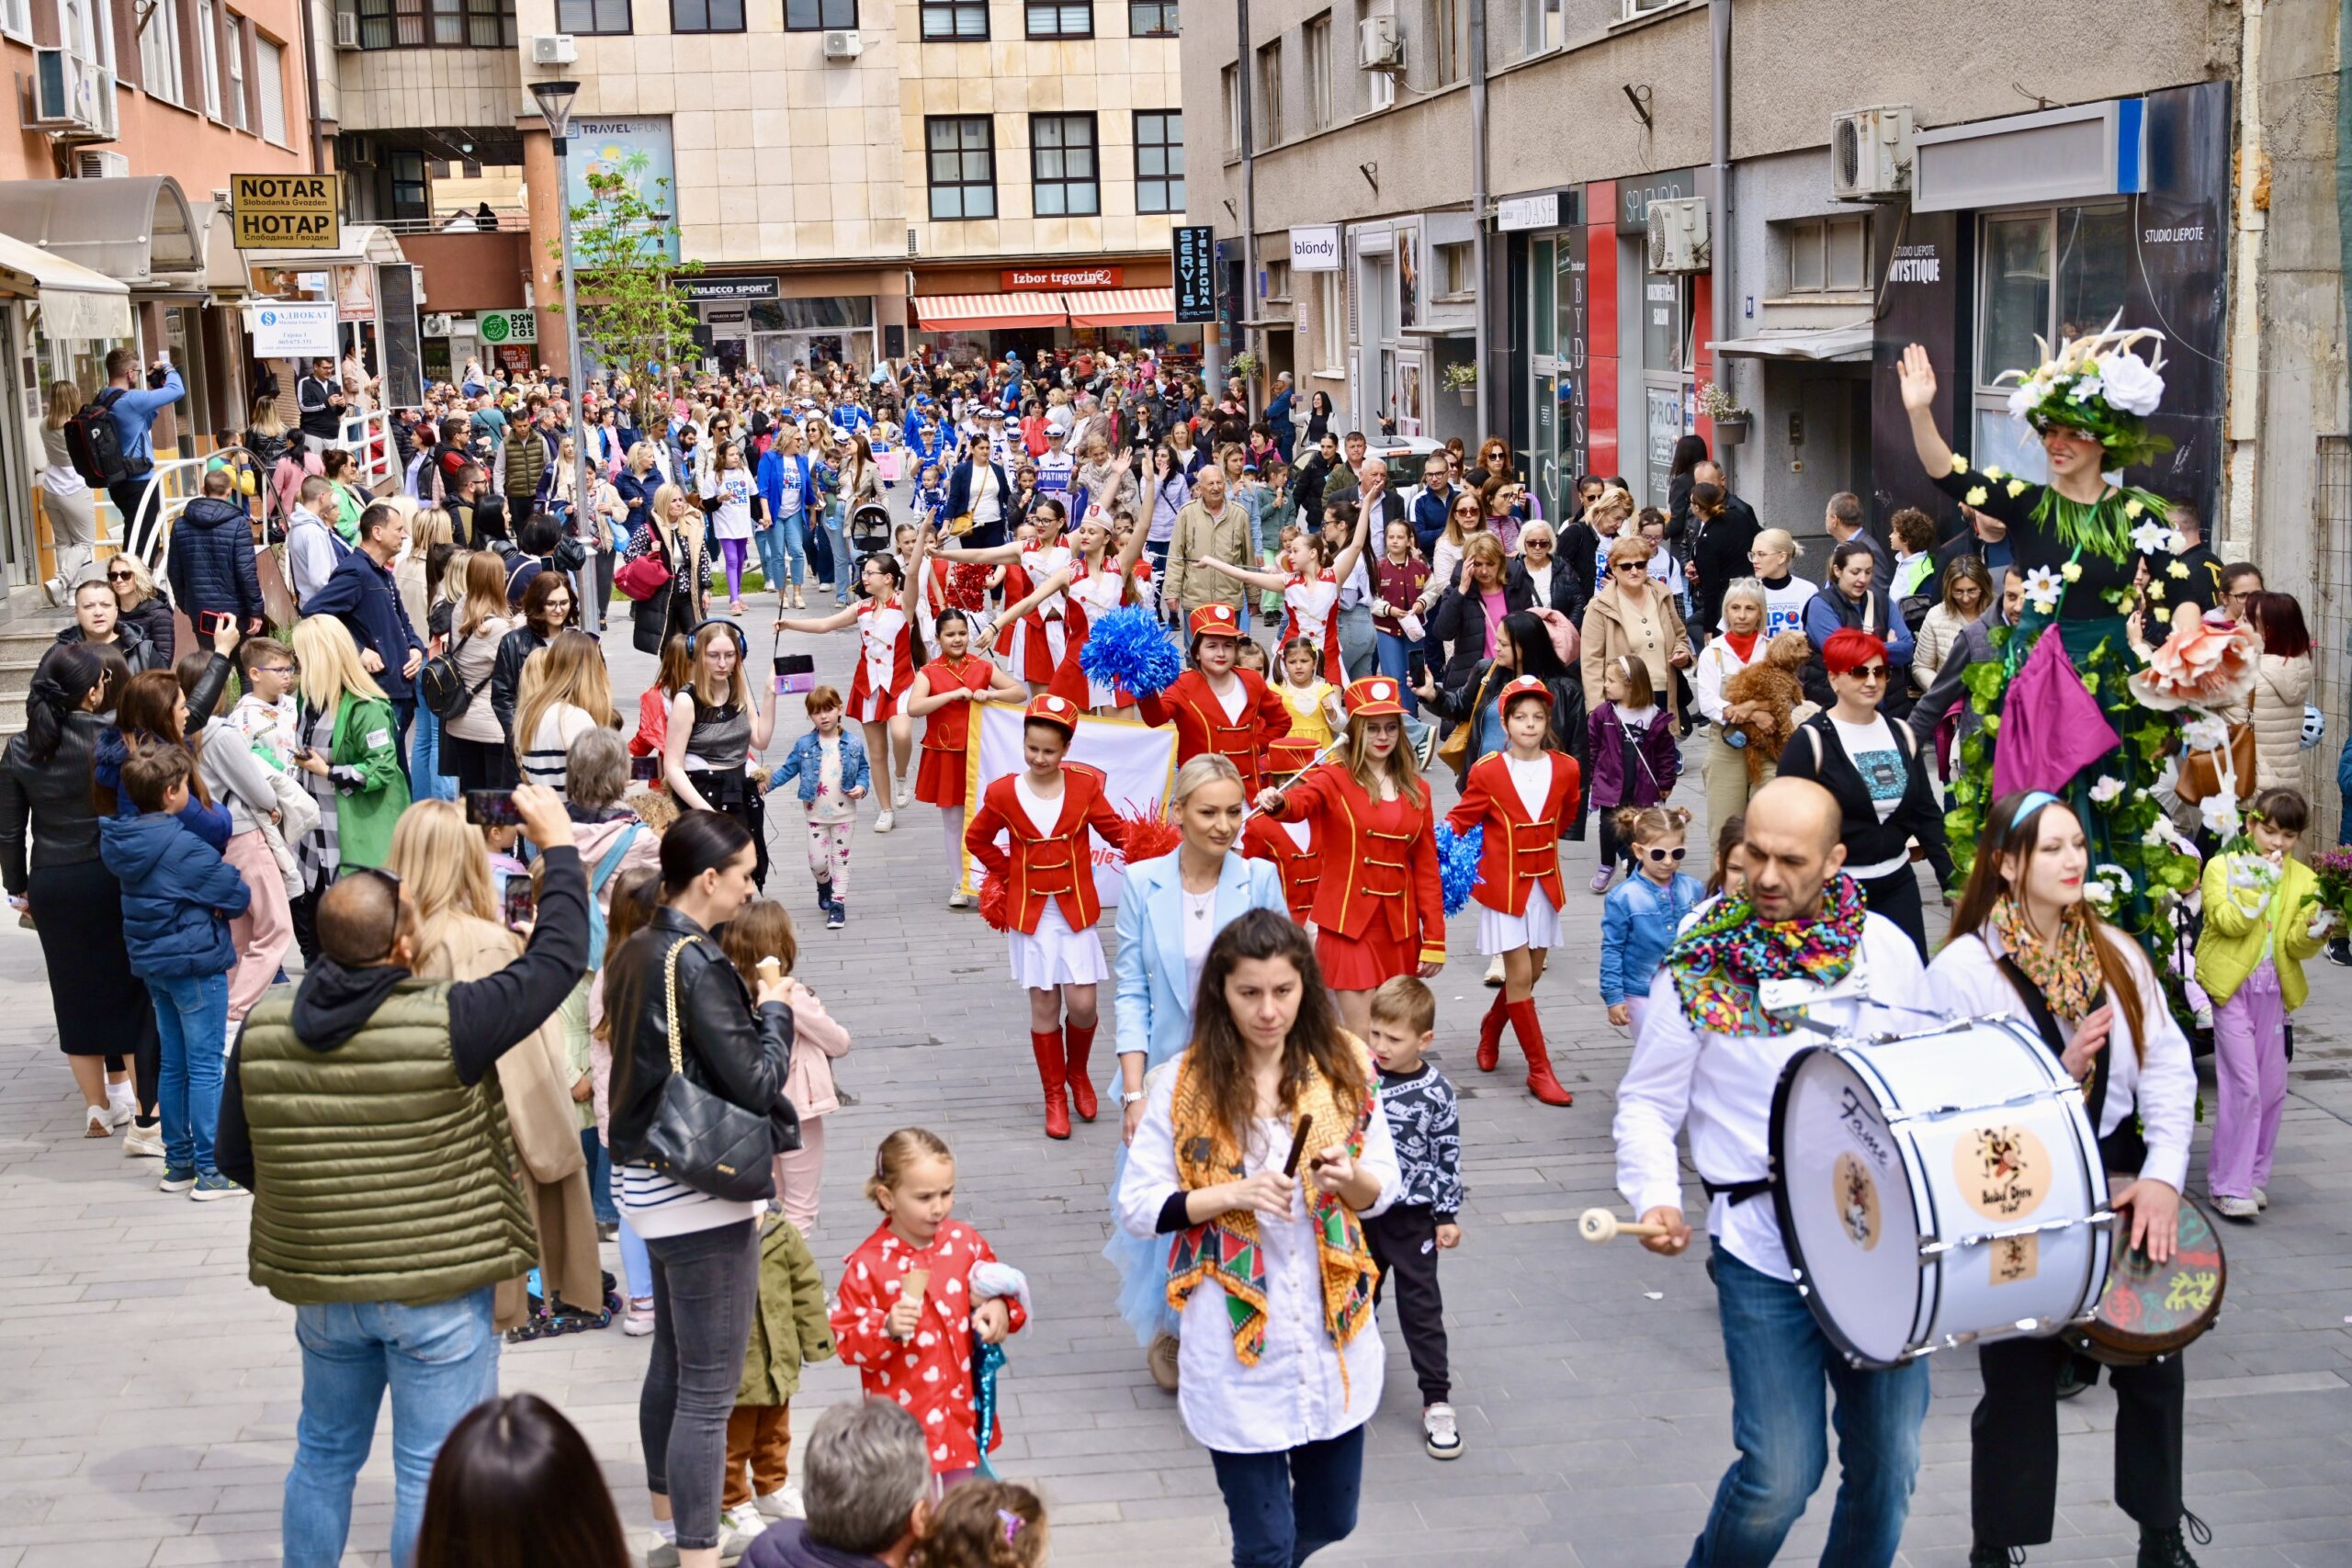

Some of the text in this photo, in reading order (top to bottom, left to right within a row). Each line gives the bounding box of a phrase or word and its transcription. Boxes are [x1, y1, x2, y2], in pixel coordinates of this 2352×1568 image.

[241, 179, 326, 198] NOTAR
[243, 198, 327, 207] Slobodanka Gvozden
[1524, 197, 1556, 226] DASH
[243, 215, 330, 234] НОТАР
[244, 233, 330, 243] Слободанка Гвозден
[2144, 228, 2172, 243] STUDIO
[1180, 230, 1195, 308] SERVIS
[1197, 230, 1211, 306] TELEFONA
[1571, 261, 1586, 274] boutique
[1889, 258, 1939, 284] MYSTIQUE
[1013, 271, 1103, 285] Izbor trgovine
[278, 311, 328, 321] АДВОКАТ
[1654, 309, 1669, 325] SALON
[1840, 1086, 1888, 1165] Fame
